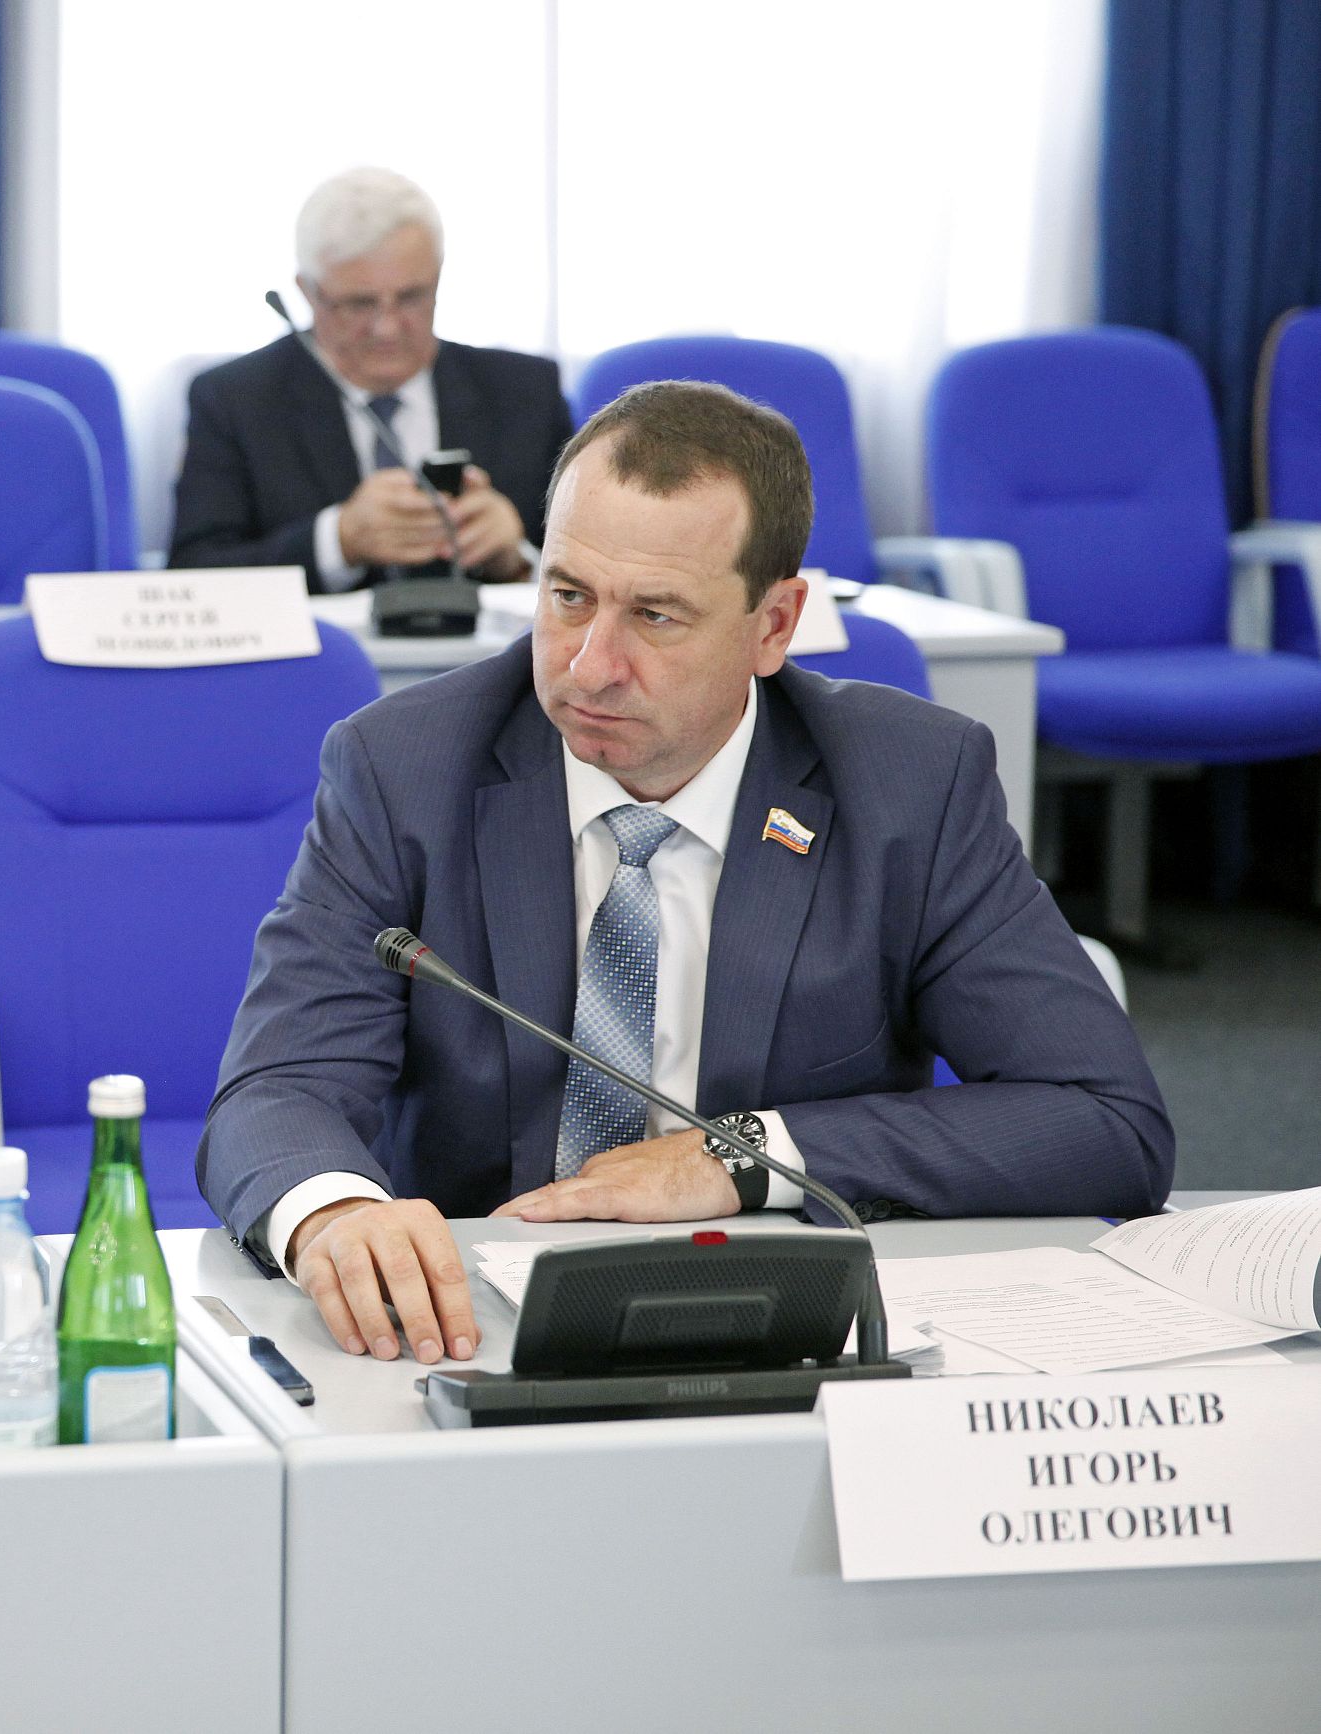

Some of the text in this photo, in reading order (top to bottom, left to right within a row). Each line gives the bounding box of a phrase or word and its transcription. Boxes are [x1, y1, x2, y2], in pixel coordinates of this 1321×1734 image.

[667, 1380, 729, 1398] PHILIPS
[966, 1392, 1226, 1434] НИКОЛАЕВ
[1027, 1450, 1178, 1488] ИГОРЬ
[980, 1503, 1234, 1546] ОЛЕГОВИЧ
